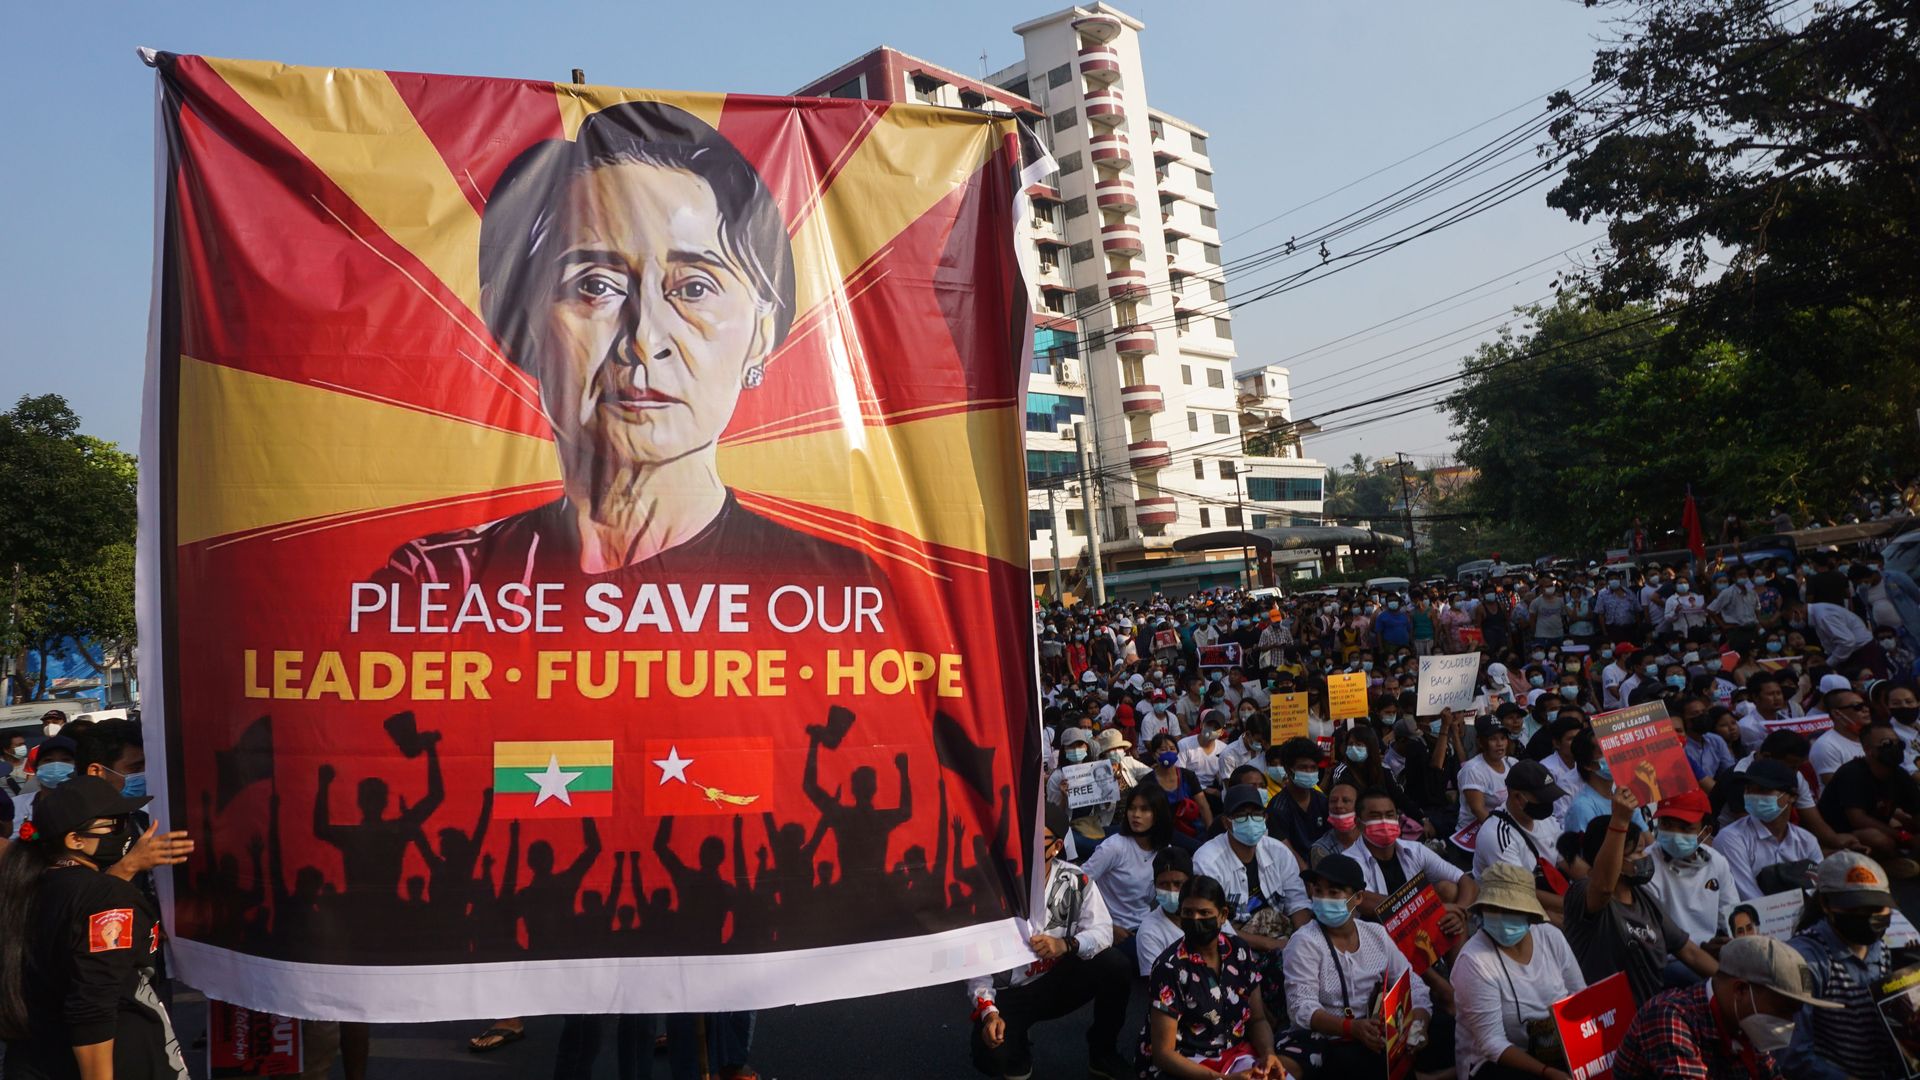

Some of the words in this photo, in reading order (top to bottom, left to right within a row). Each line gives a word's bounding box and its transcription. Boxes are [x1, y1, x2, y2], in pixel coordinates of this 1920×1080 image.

[350, 582, 565, 633] PLEASE
[584, 582, 749, 633] SAVE
[767, 584, 885, 633] OUR
[244, 649, 493, 700] LEADER
[536, 649, 787, 699] FUTURE
[826, 648, 964, 697] HOPE
[1430, 676, 1453, 687] BACK
[1460, 673, 1469, 685] TO
[1611, 721, 1626, 732] OUR
[1626, 714, 1651, 728] LEADER
[1600, 736, 1620, 750] AUNG
[1619, 731, 1635, 745] SAN
[1634, 727, 1645, 741] SU
[1645, 724, 1658, 738] KYI
[1067, 784, 1094, 797] FREE
[1391, 901, 1402, 913] OUR
[1401, 887, 1419, 904] LEADER
[1580, 1017, 1598, 1039] SAY
[1597, 1008, 1616, 1029] "NO"
[1573, 1066, 1587, 1080] TO
